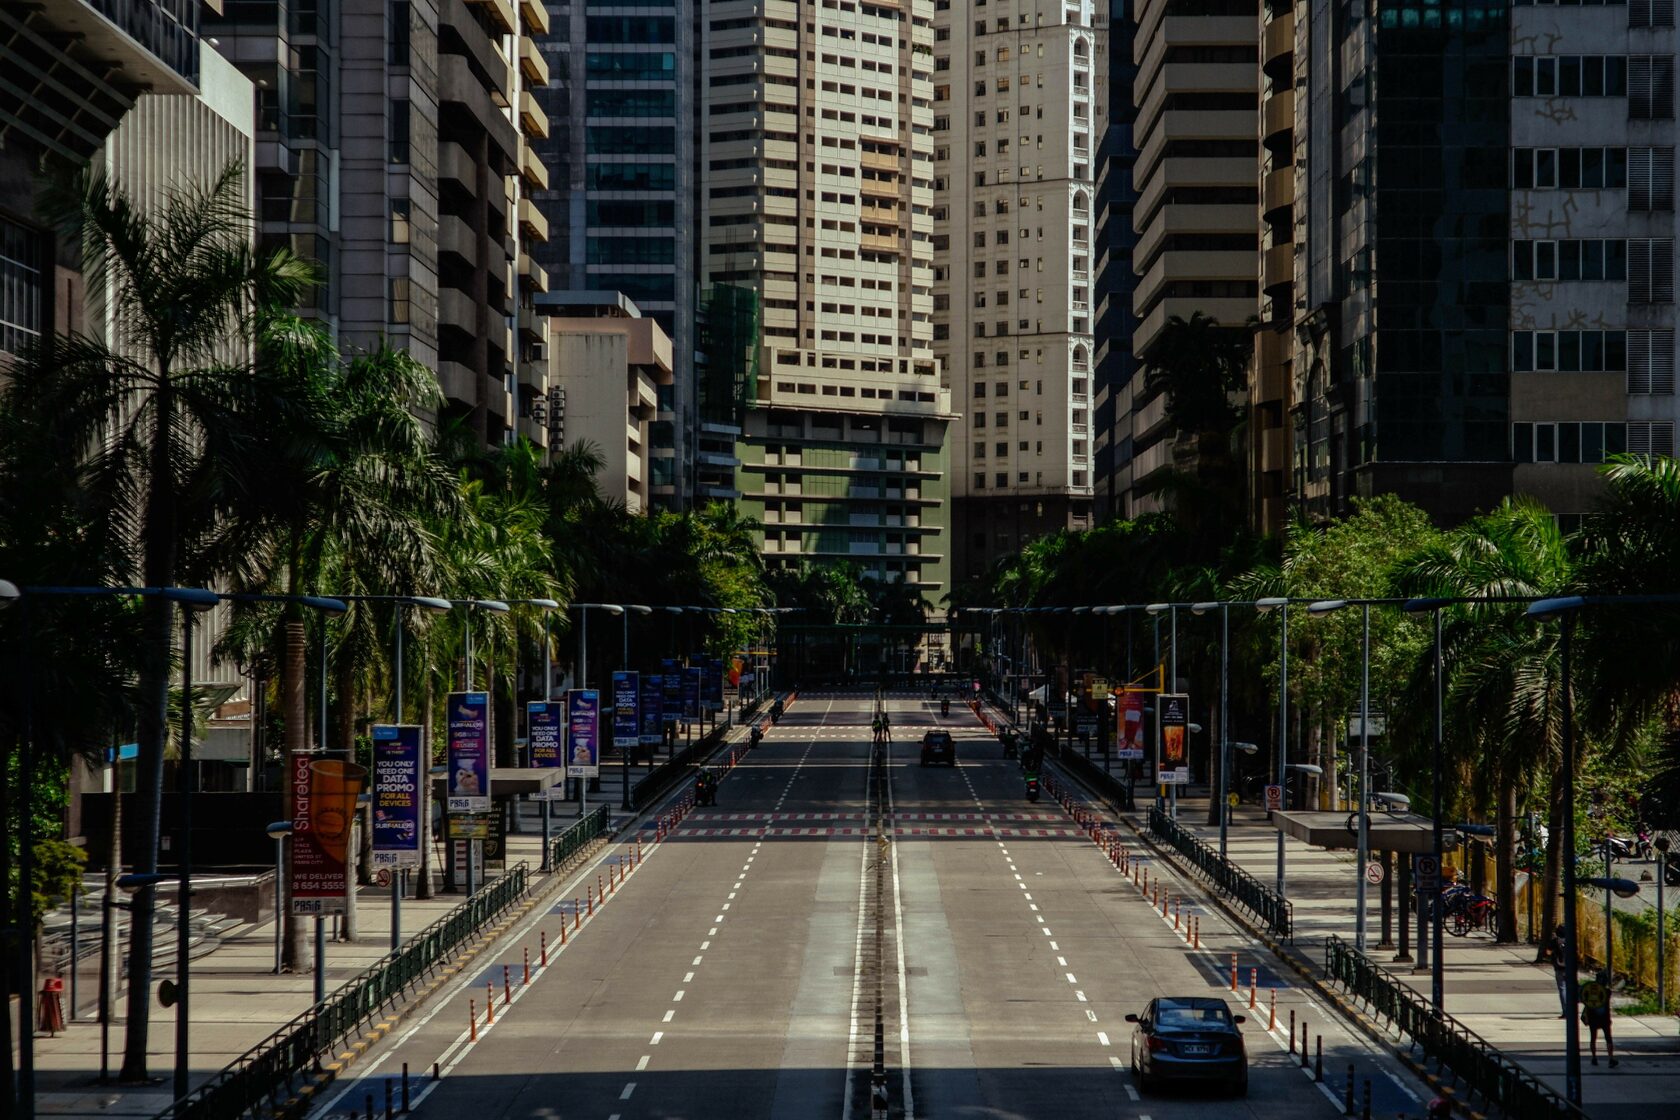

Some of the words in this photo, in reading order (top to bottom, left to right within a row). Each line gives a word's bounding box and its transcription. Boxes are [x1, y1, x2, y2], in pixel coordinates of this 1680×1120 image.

[383, 775, 408, 783] DATA
[377, 784, 415, 792] PROMO
[293, 758, 309, 830] Sharetea
